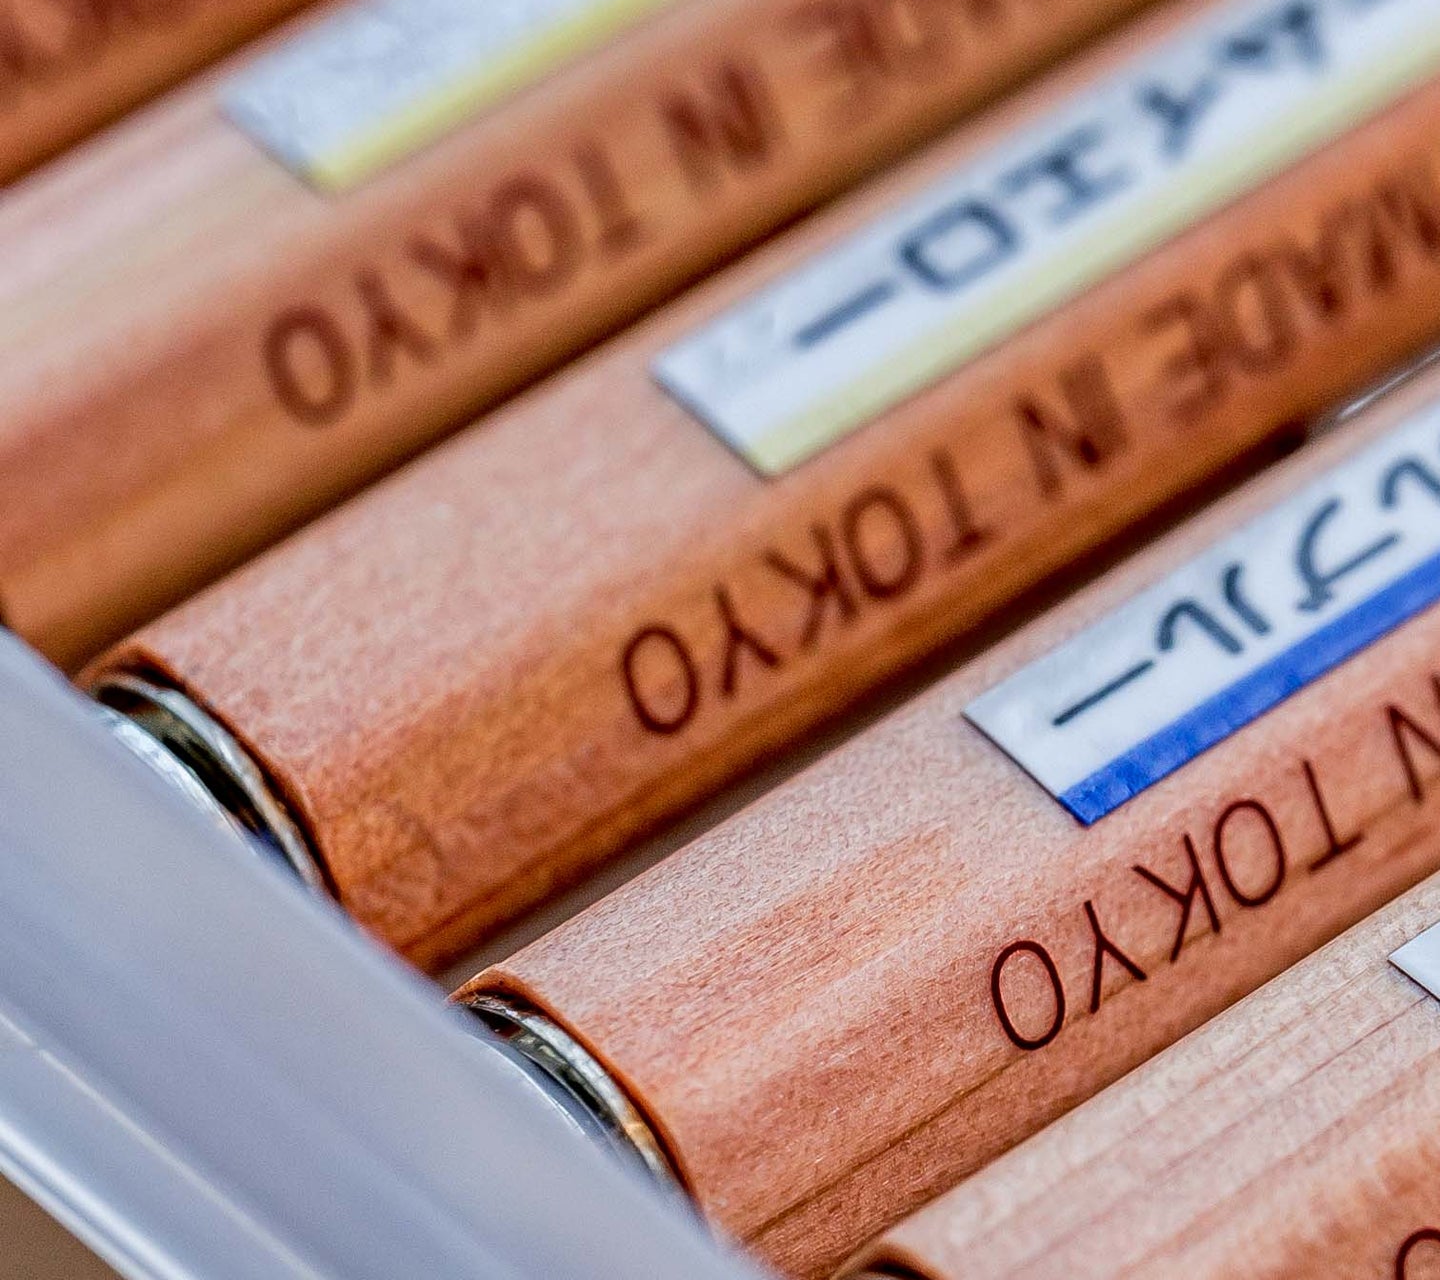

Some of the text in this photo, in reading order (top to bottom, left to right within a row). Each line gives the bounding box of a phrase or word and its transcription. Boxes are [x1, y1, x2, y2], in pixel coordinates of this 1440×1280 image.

[657, 52, 776, 190] IN
[256, 138, 645, 436] TOKYO
[1144, 179, 1440, 431] MADE
[1014, 365, 1128, 501] IN
[616, 451, 997, 741] TOKYO
[987, 759, 1362, 1064] TOKYO
